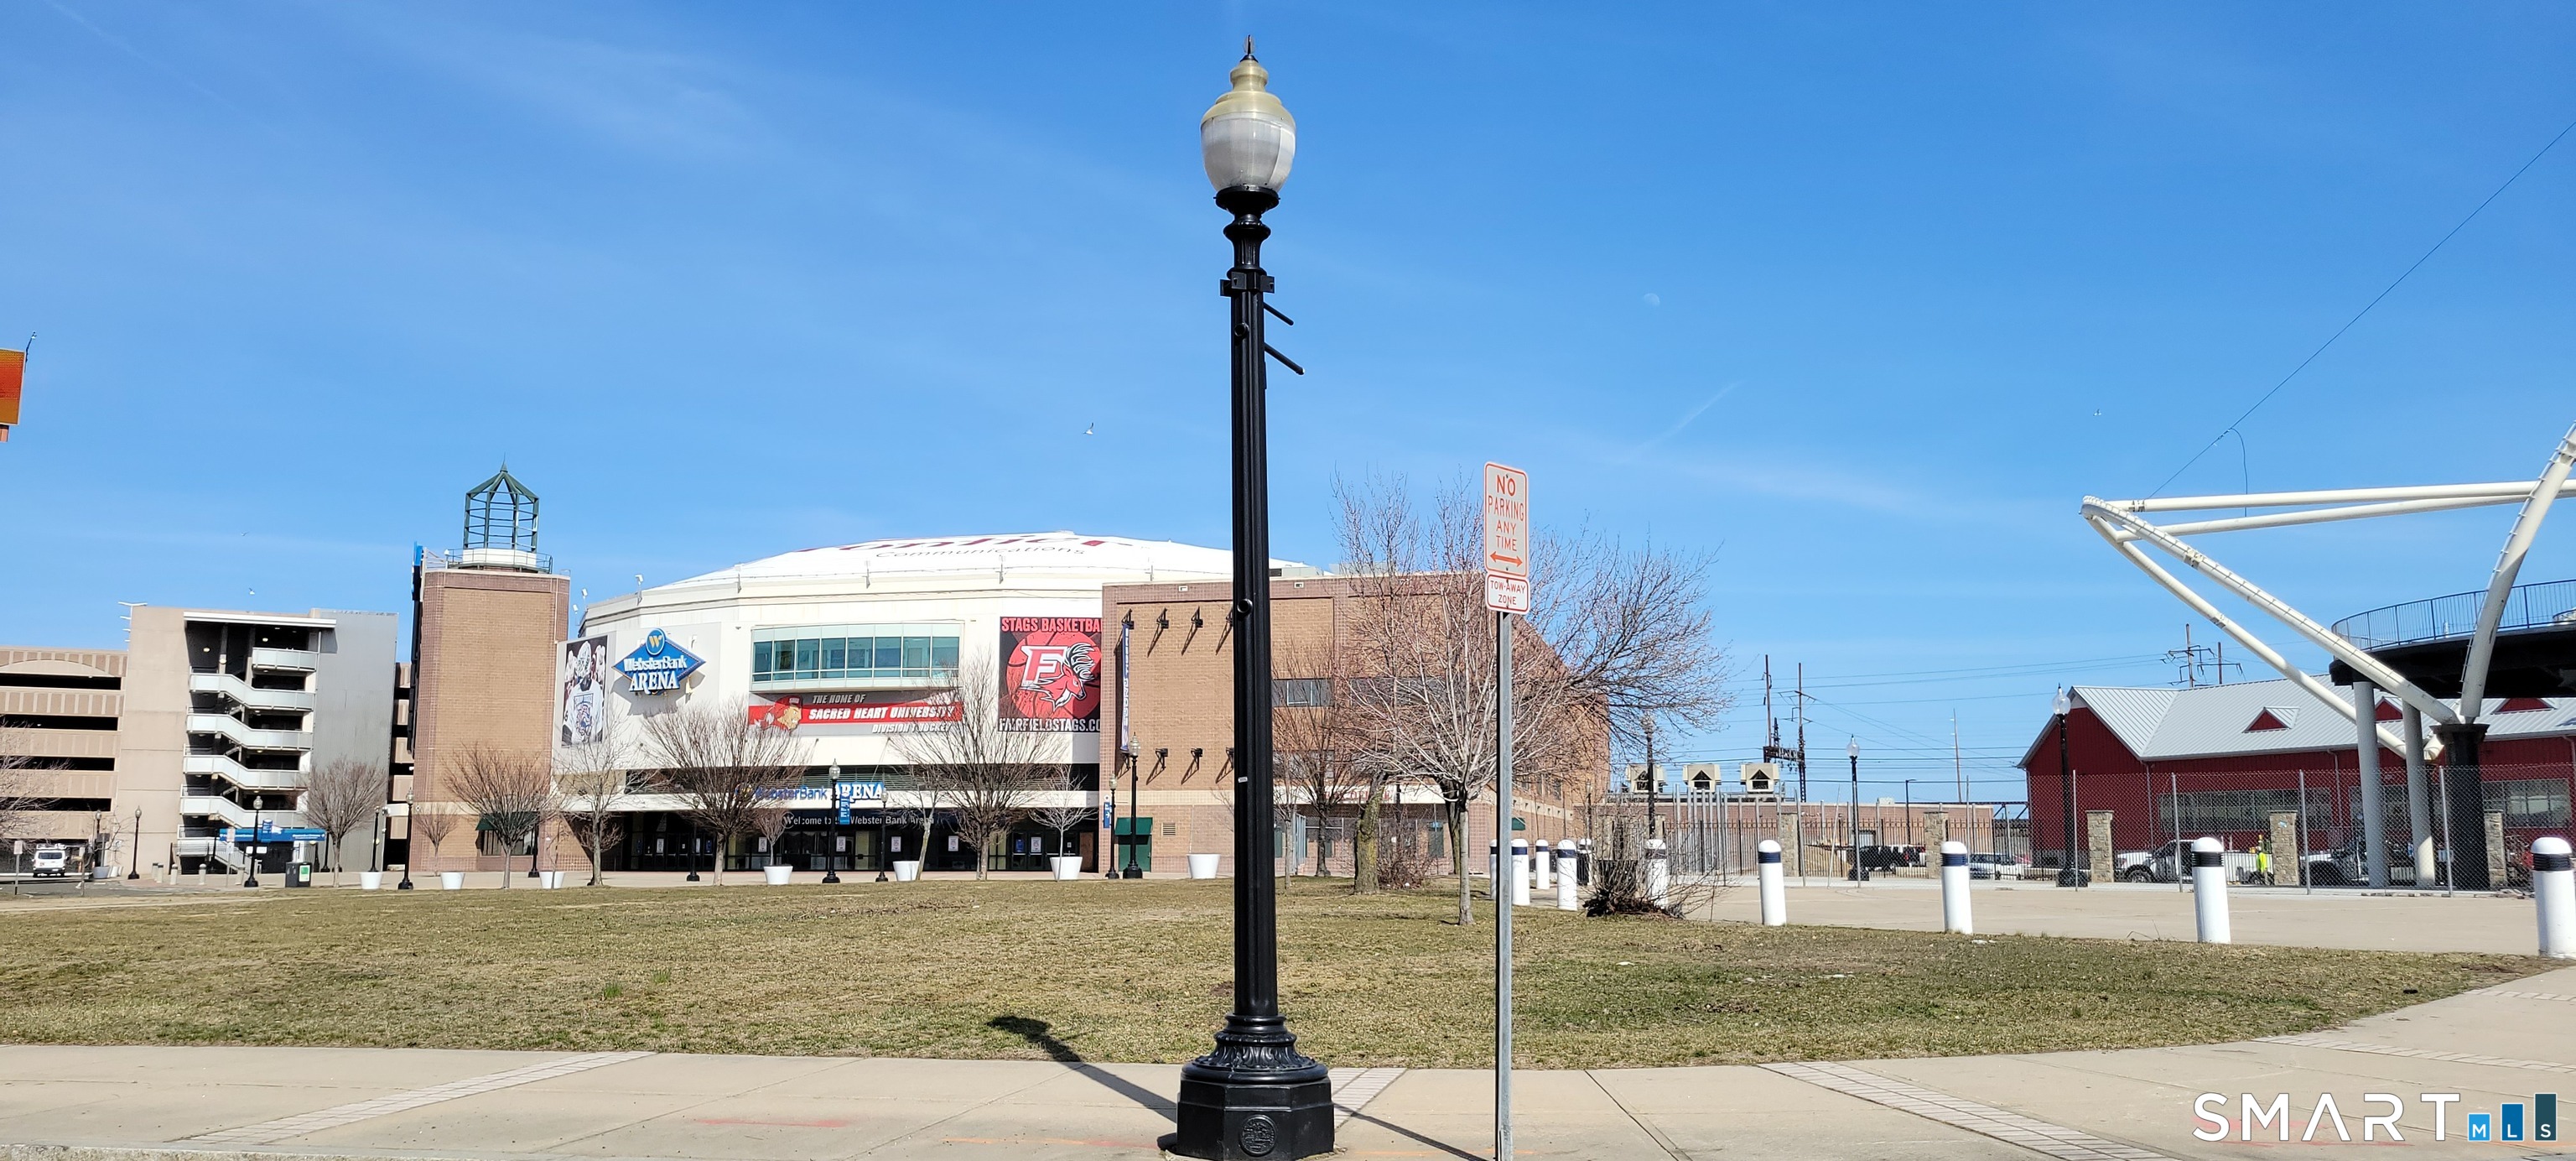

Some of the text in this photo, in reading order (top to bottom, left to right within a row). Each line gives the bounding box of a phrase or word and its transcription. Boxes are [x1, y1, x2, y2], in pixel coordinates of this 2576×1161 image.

[1496, 475, 1516, 497] NO
[1488, 495, 1524, 522] PARKING
[1496, 519, 1517, 535] ANY
[1495, 535, 1517, 552] TIME
[875, 545, 1086, 558] Communications
[1490, 580, 1526, 594] TOW-AWAY
[1498, 594, 1517, 605] ZONE
[1001, 617, 1102, 633] STAGS BASKETBA
[623, 655, 688, 671] WebsterBank
[629, 671, 678, 695] ARENA
[813, 694, 866, 704] THE HOME OF
[808, 705, 955, 720] SACRED HEART UNIVERSITY
[872, 723, 910, 733] DIVISION
[782, 815, 822, 825] Welcome
[849, 815, 882, 825] Webster
[886, 815, 906, 825] Bank
